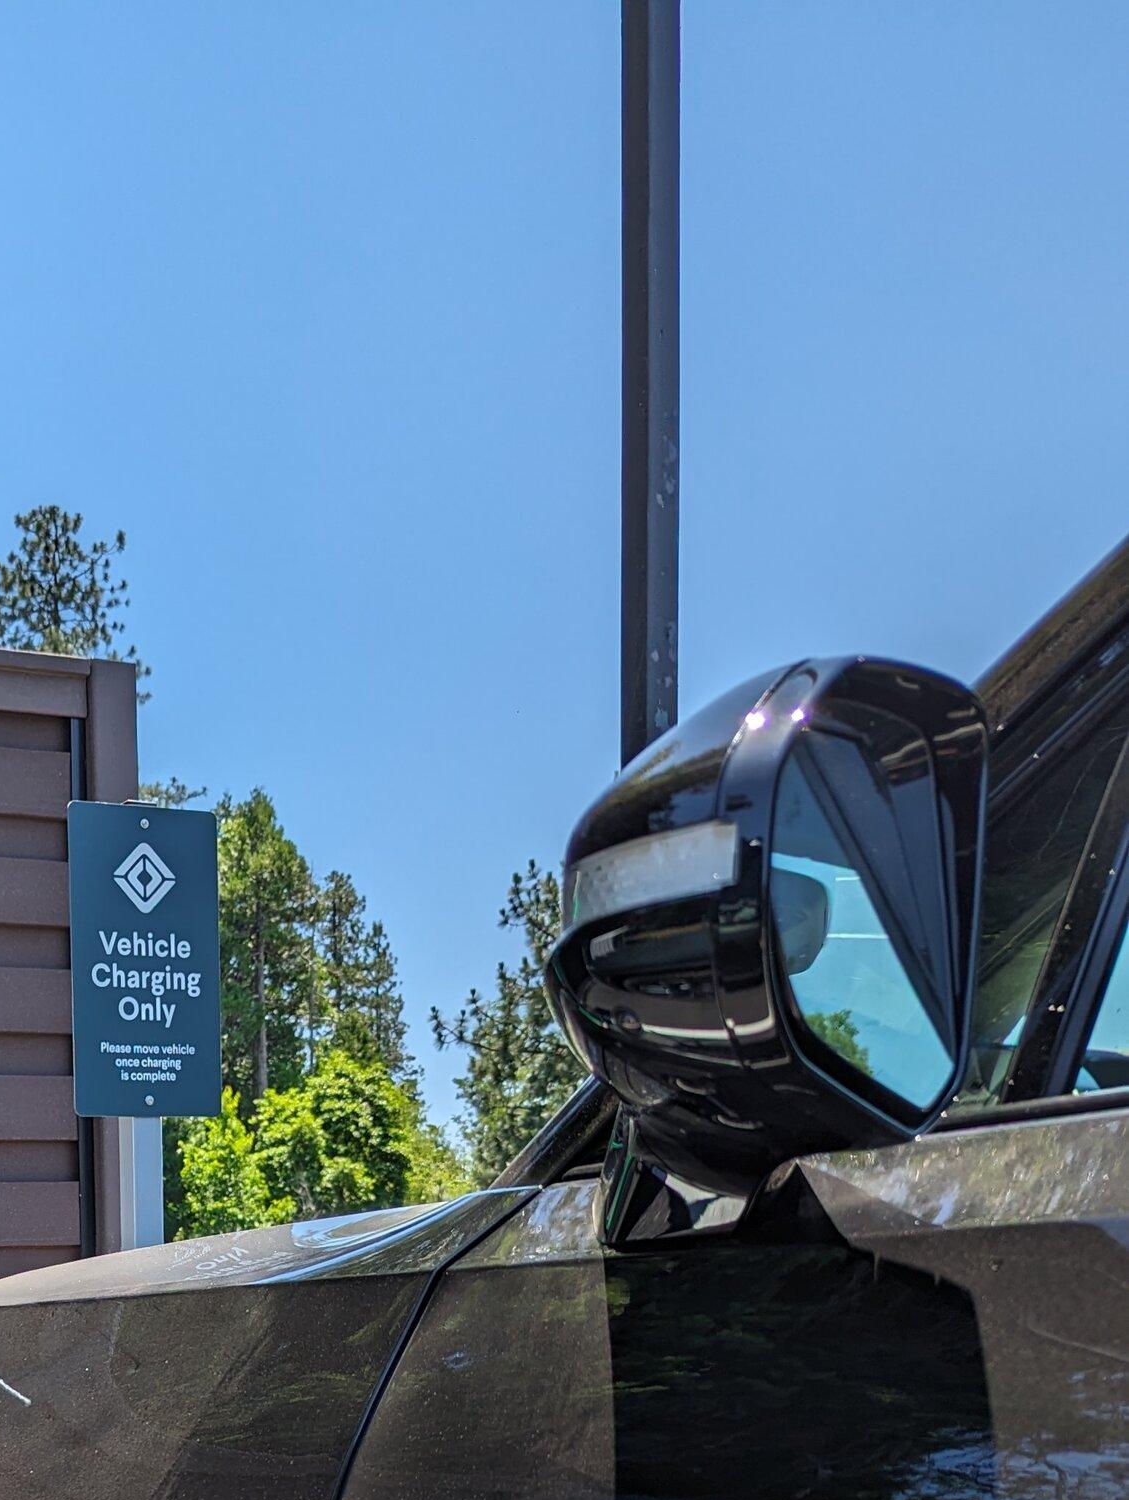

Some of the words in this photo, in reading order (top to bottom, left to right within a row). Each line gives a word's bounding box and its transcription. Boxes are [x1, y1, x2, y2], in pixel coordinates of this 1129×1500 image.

[98, 931, 191, 959] Vehicle
[91, 962, 201, 998] Charging
[118, 996, 176, 1028] Only
[100, 1042, 131, 1054] Please
[133, 1044, 159, 1055] move
[160, 1044, 195, 1055] vehicle
[115, 1058, 140, 1067] once
[141, 1057, 182, 1071] charging
[121, 1070, 128, 1080] is
[130, 1071, 176, 1083] complete
